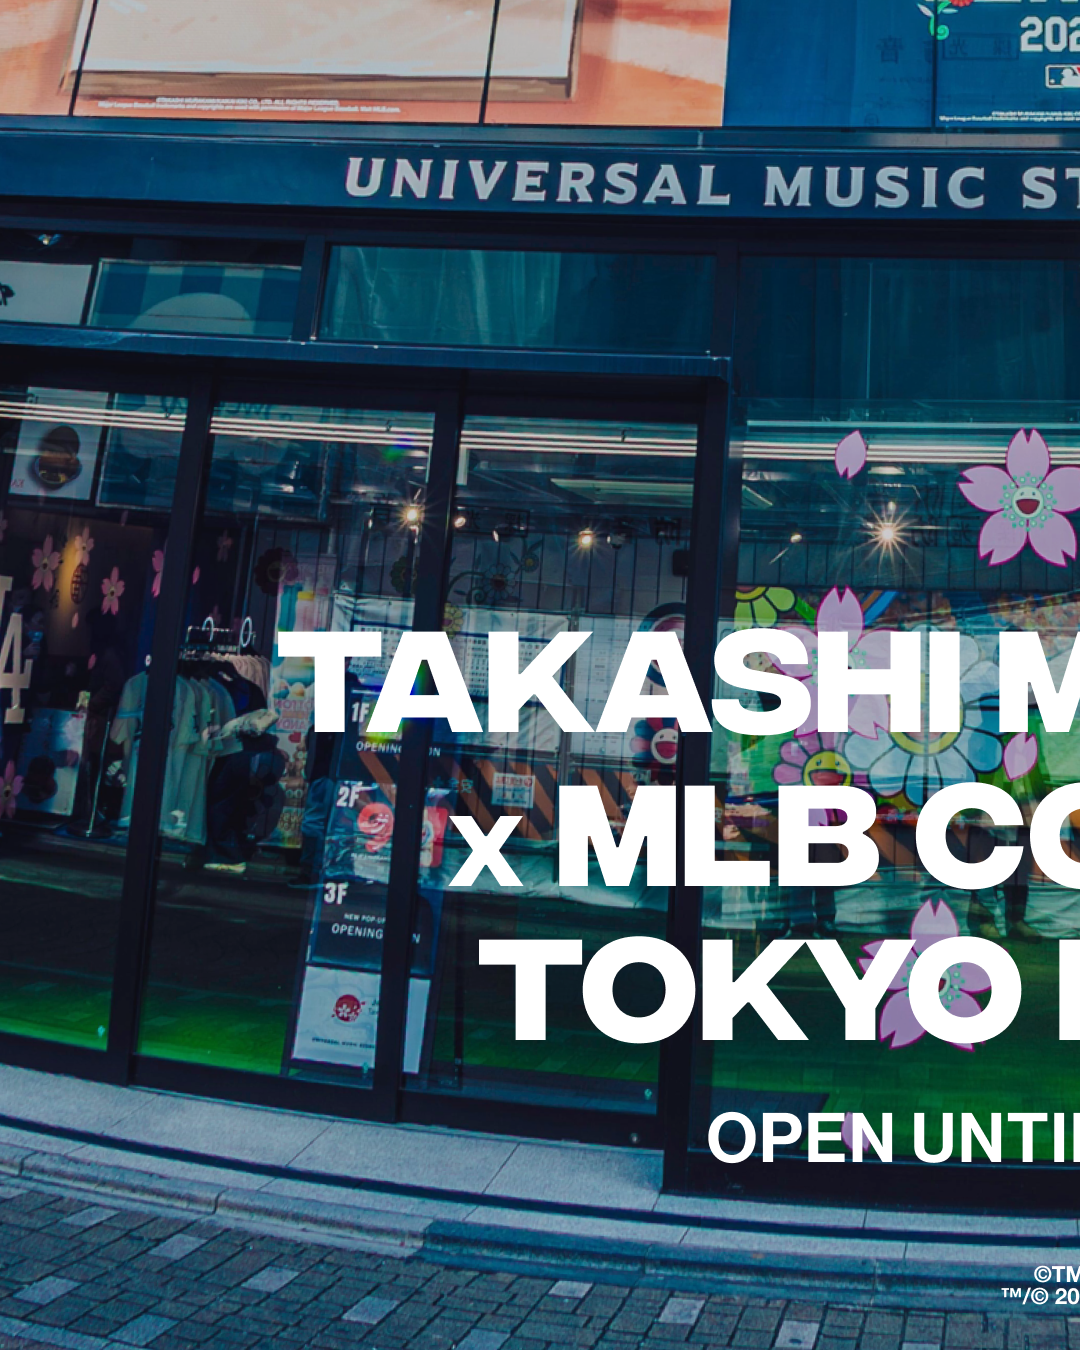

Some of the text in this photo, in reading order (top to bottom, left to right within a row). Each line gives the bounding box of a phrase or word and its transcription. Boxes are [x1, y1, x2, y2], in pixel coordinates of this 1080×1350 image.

[346, 157, 730, 205] UNIVERSAL
[765, 166, 985, 207] MUSIC
[336, 786, 360, 807] 2F
[324, 882, 349, 905] 3F
[331, 922, 384, 940] OPENING
